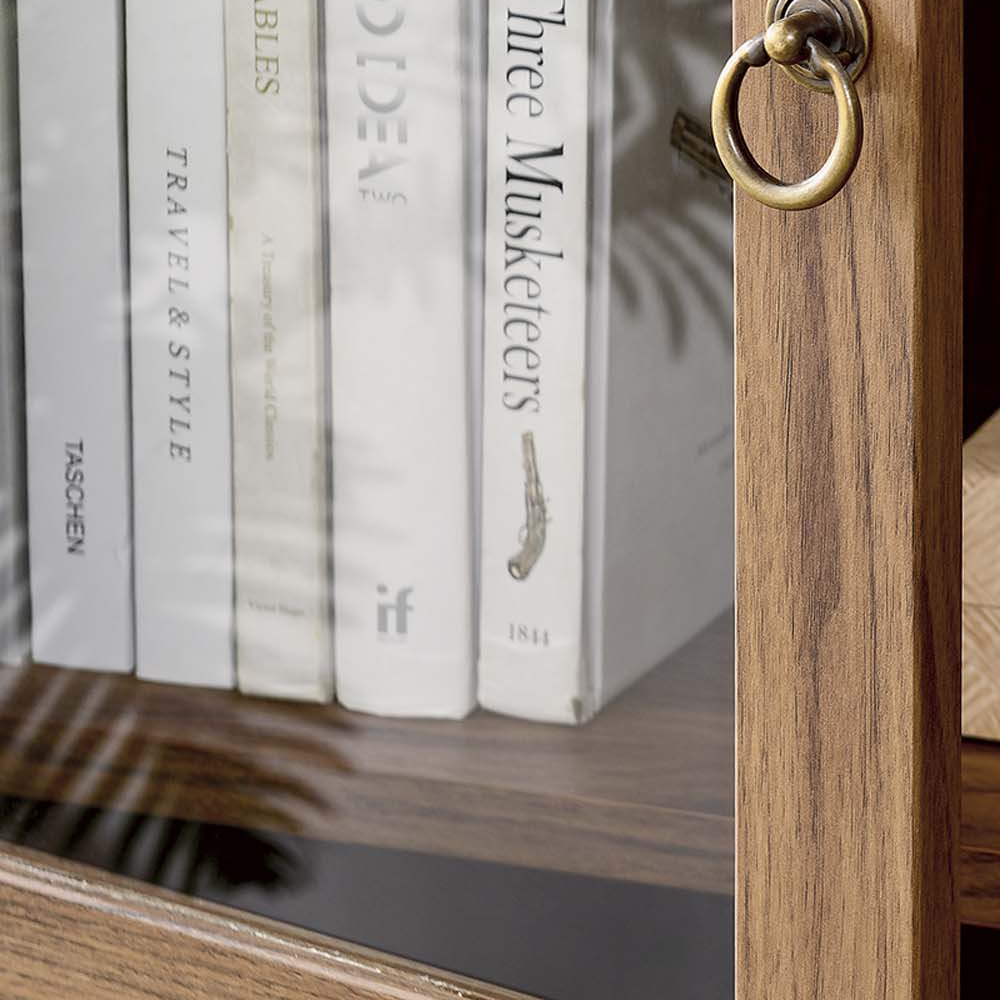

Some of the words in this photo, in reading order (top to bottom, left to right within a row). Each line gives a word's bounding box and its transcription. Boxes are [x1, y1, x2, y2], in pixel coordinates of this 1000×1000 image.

[164, 146, 190, 294] TRAVEL
[502, 134, 565, 413] Musketeers
[166, 305, 191, 329] &
[167, 339, 193, 464] STYLE
[63, 438, 86, 556] TASCHEN
